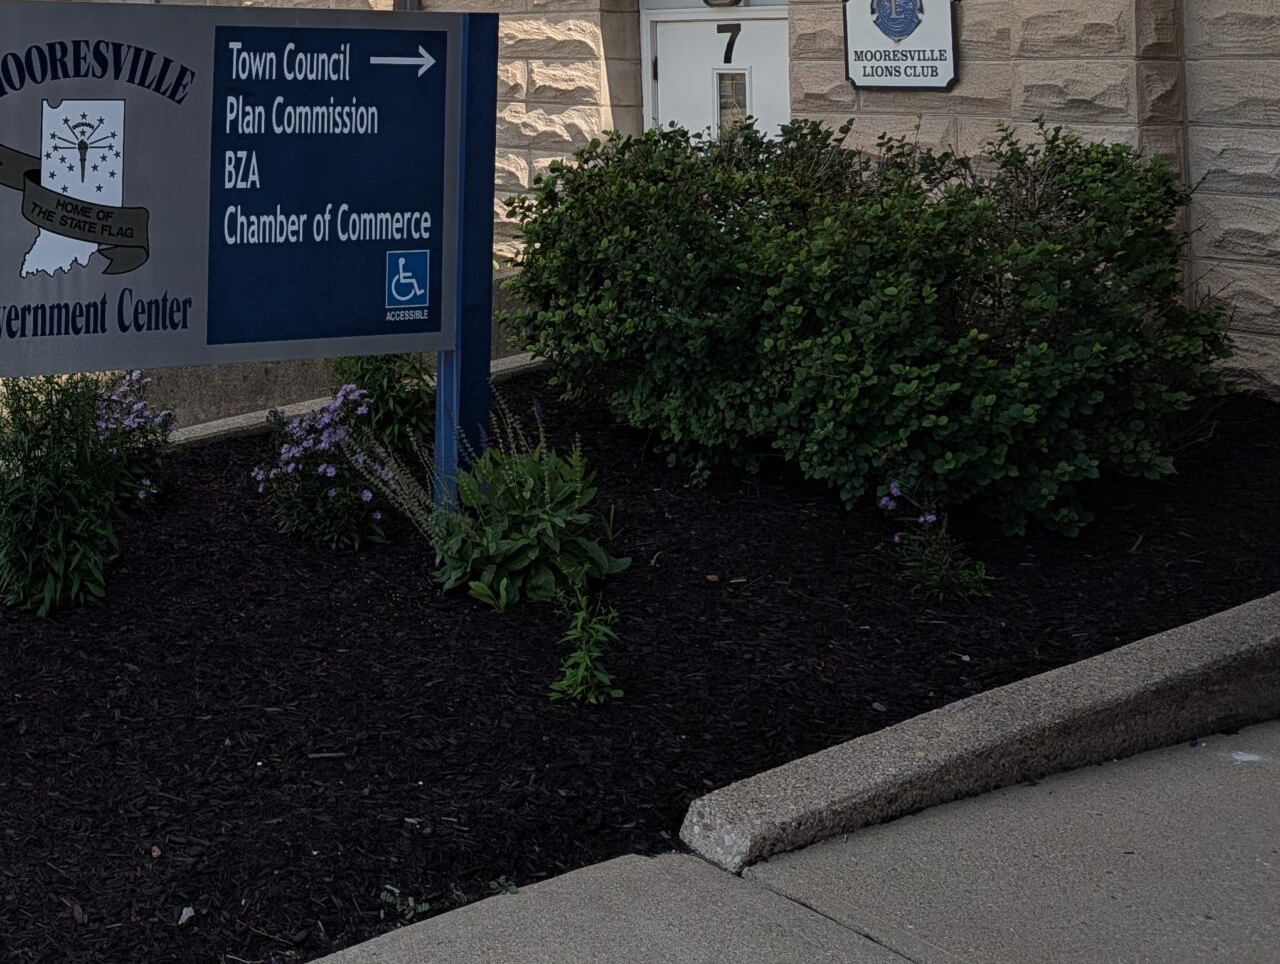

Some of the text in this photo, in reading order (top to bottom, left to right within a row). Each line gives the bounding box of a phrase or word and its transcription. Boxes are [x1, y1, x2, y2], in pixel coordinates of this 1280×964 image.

[228, 41, 351, 82] Town Council
[716, 23, 742, 64] 7
[853, 49, 948, 62] MOORESVILLE
[862, 65, 939, 78] LIONS CLUB
[225, 95, 379, 134] Plan Commission
[224, 150, 261, 190] BZA
[29, 202, 135, 239] THE STATE FLAG
[55, 198, 115, 223] HOME OF
[223, 203, 432, 245] Chamber of Commerce
[116, 287, 193, 334] Center
[385, 309, 429, 321] ACCESSIBLE
